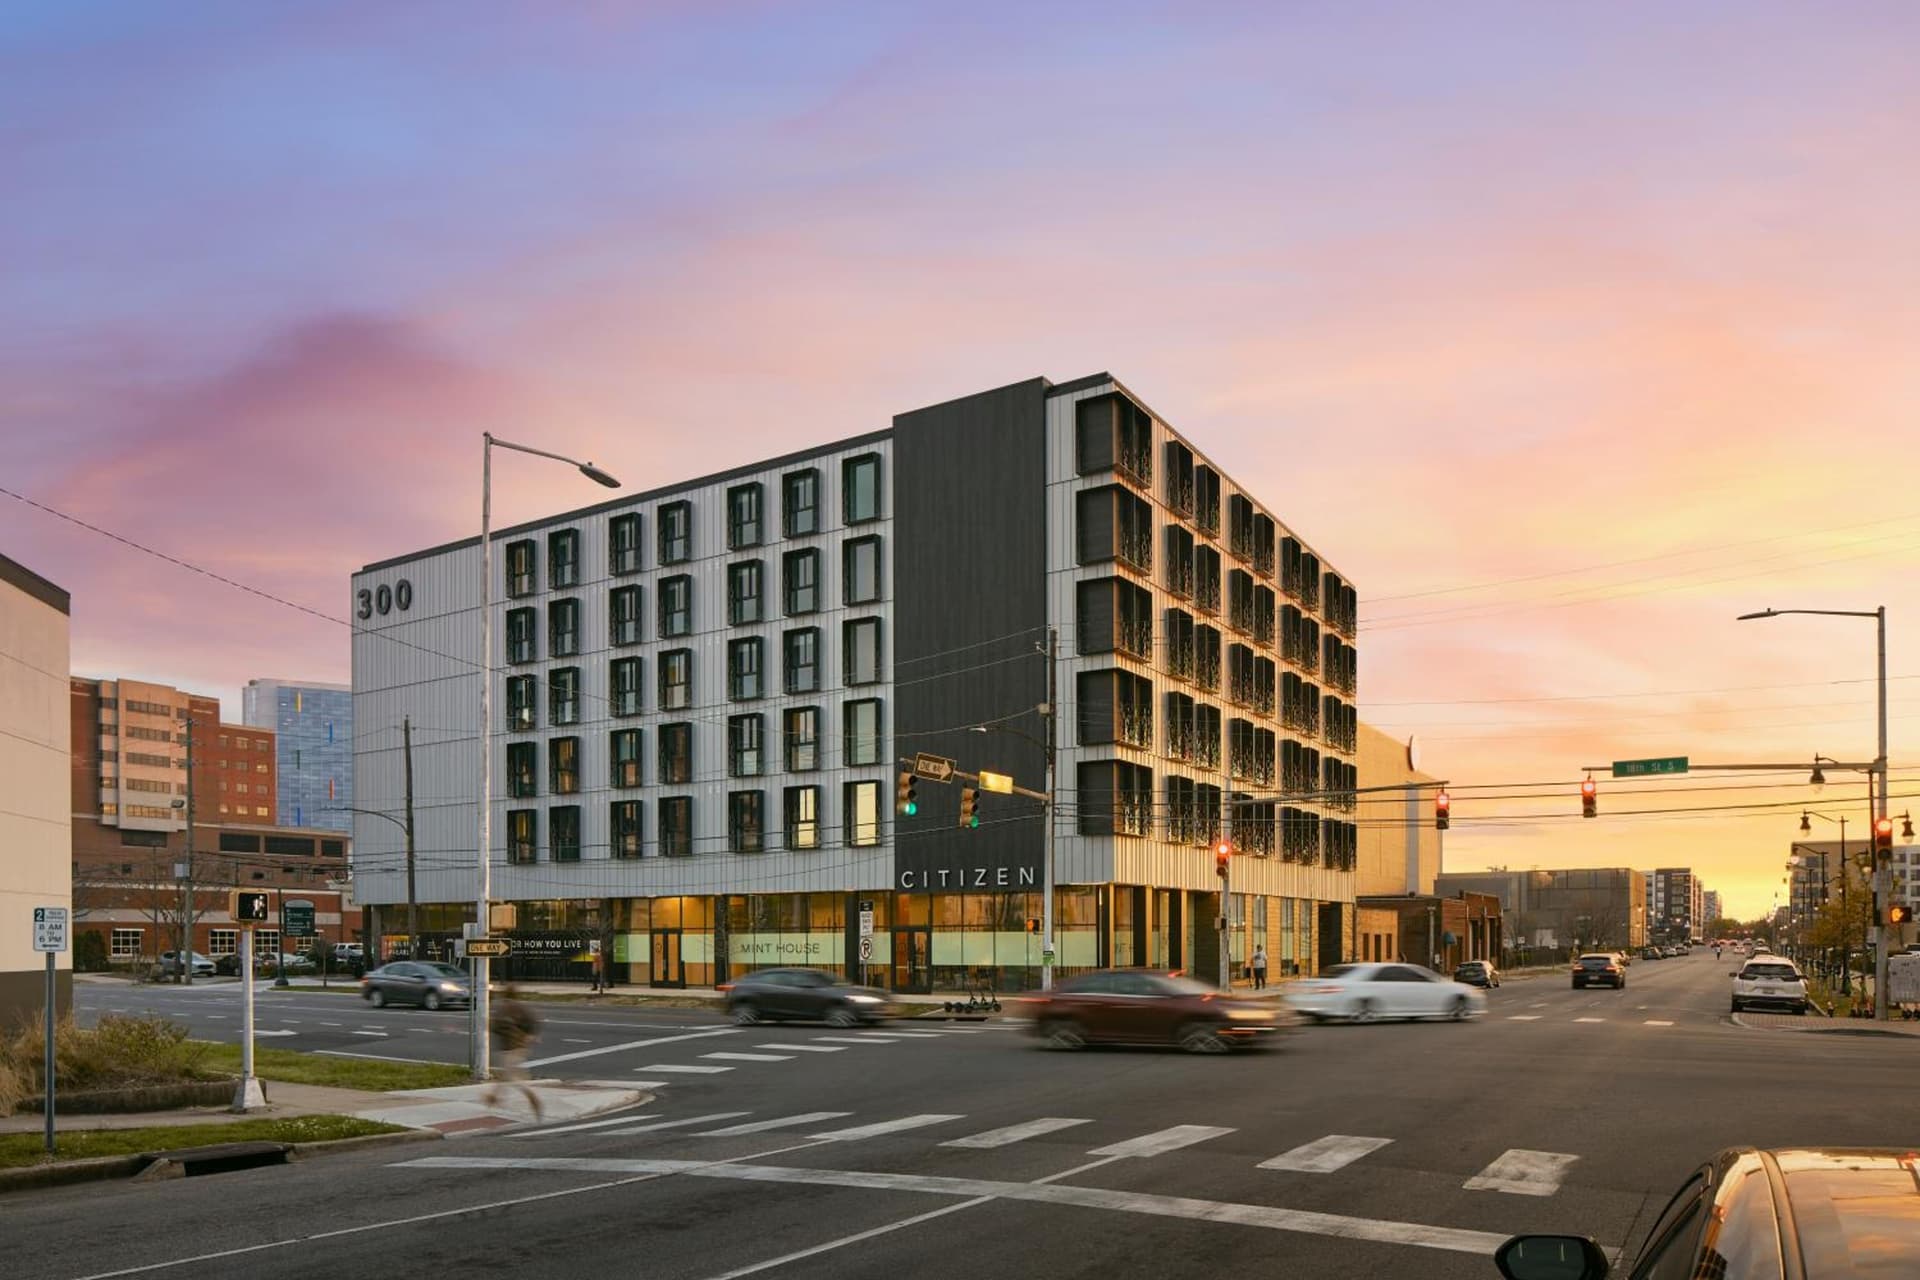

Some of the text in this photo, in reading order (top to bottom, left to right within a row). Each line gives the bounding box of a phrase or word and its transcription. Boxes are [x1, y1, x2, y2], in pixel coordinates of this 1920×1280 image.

[357, 579, 412, 620] 300
[901, 867, 1033, 888] CITIZEN
[36, 910, 43, 921] 2
[471, 943, 483, 952] ONE
[511, 940, 581, 949] OR HOW YOU LIVE
[741, 943, 820, 954] MINT HOUSE
